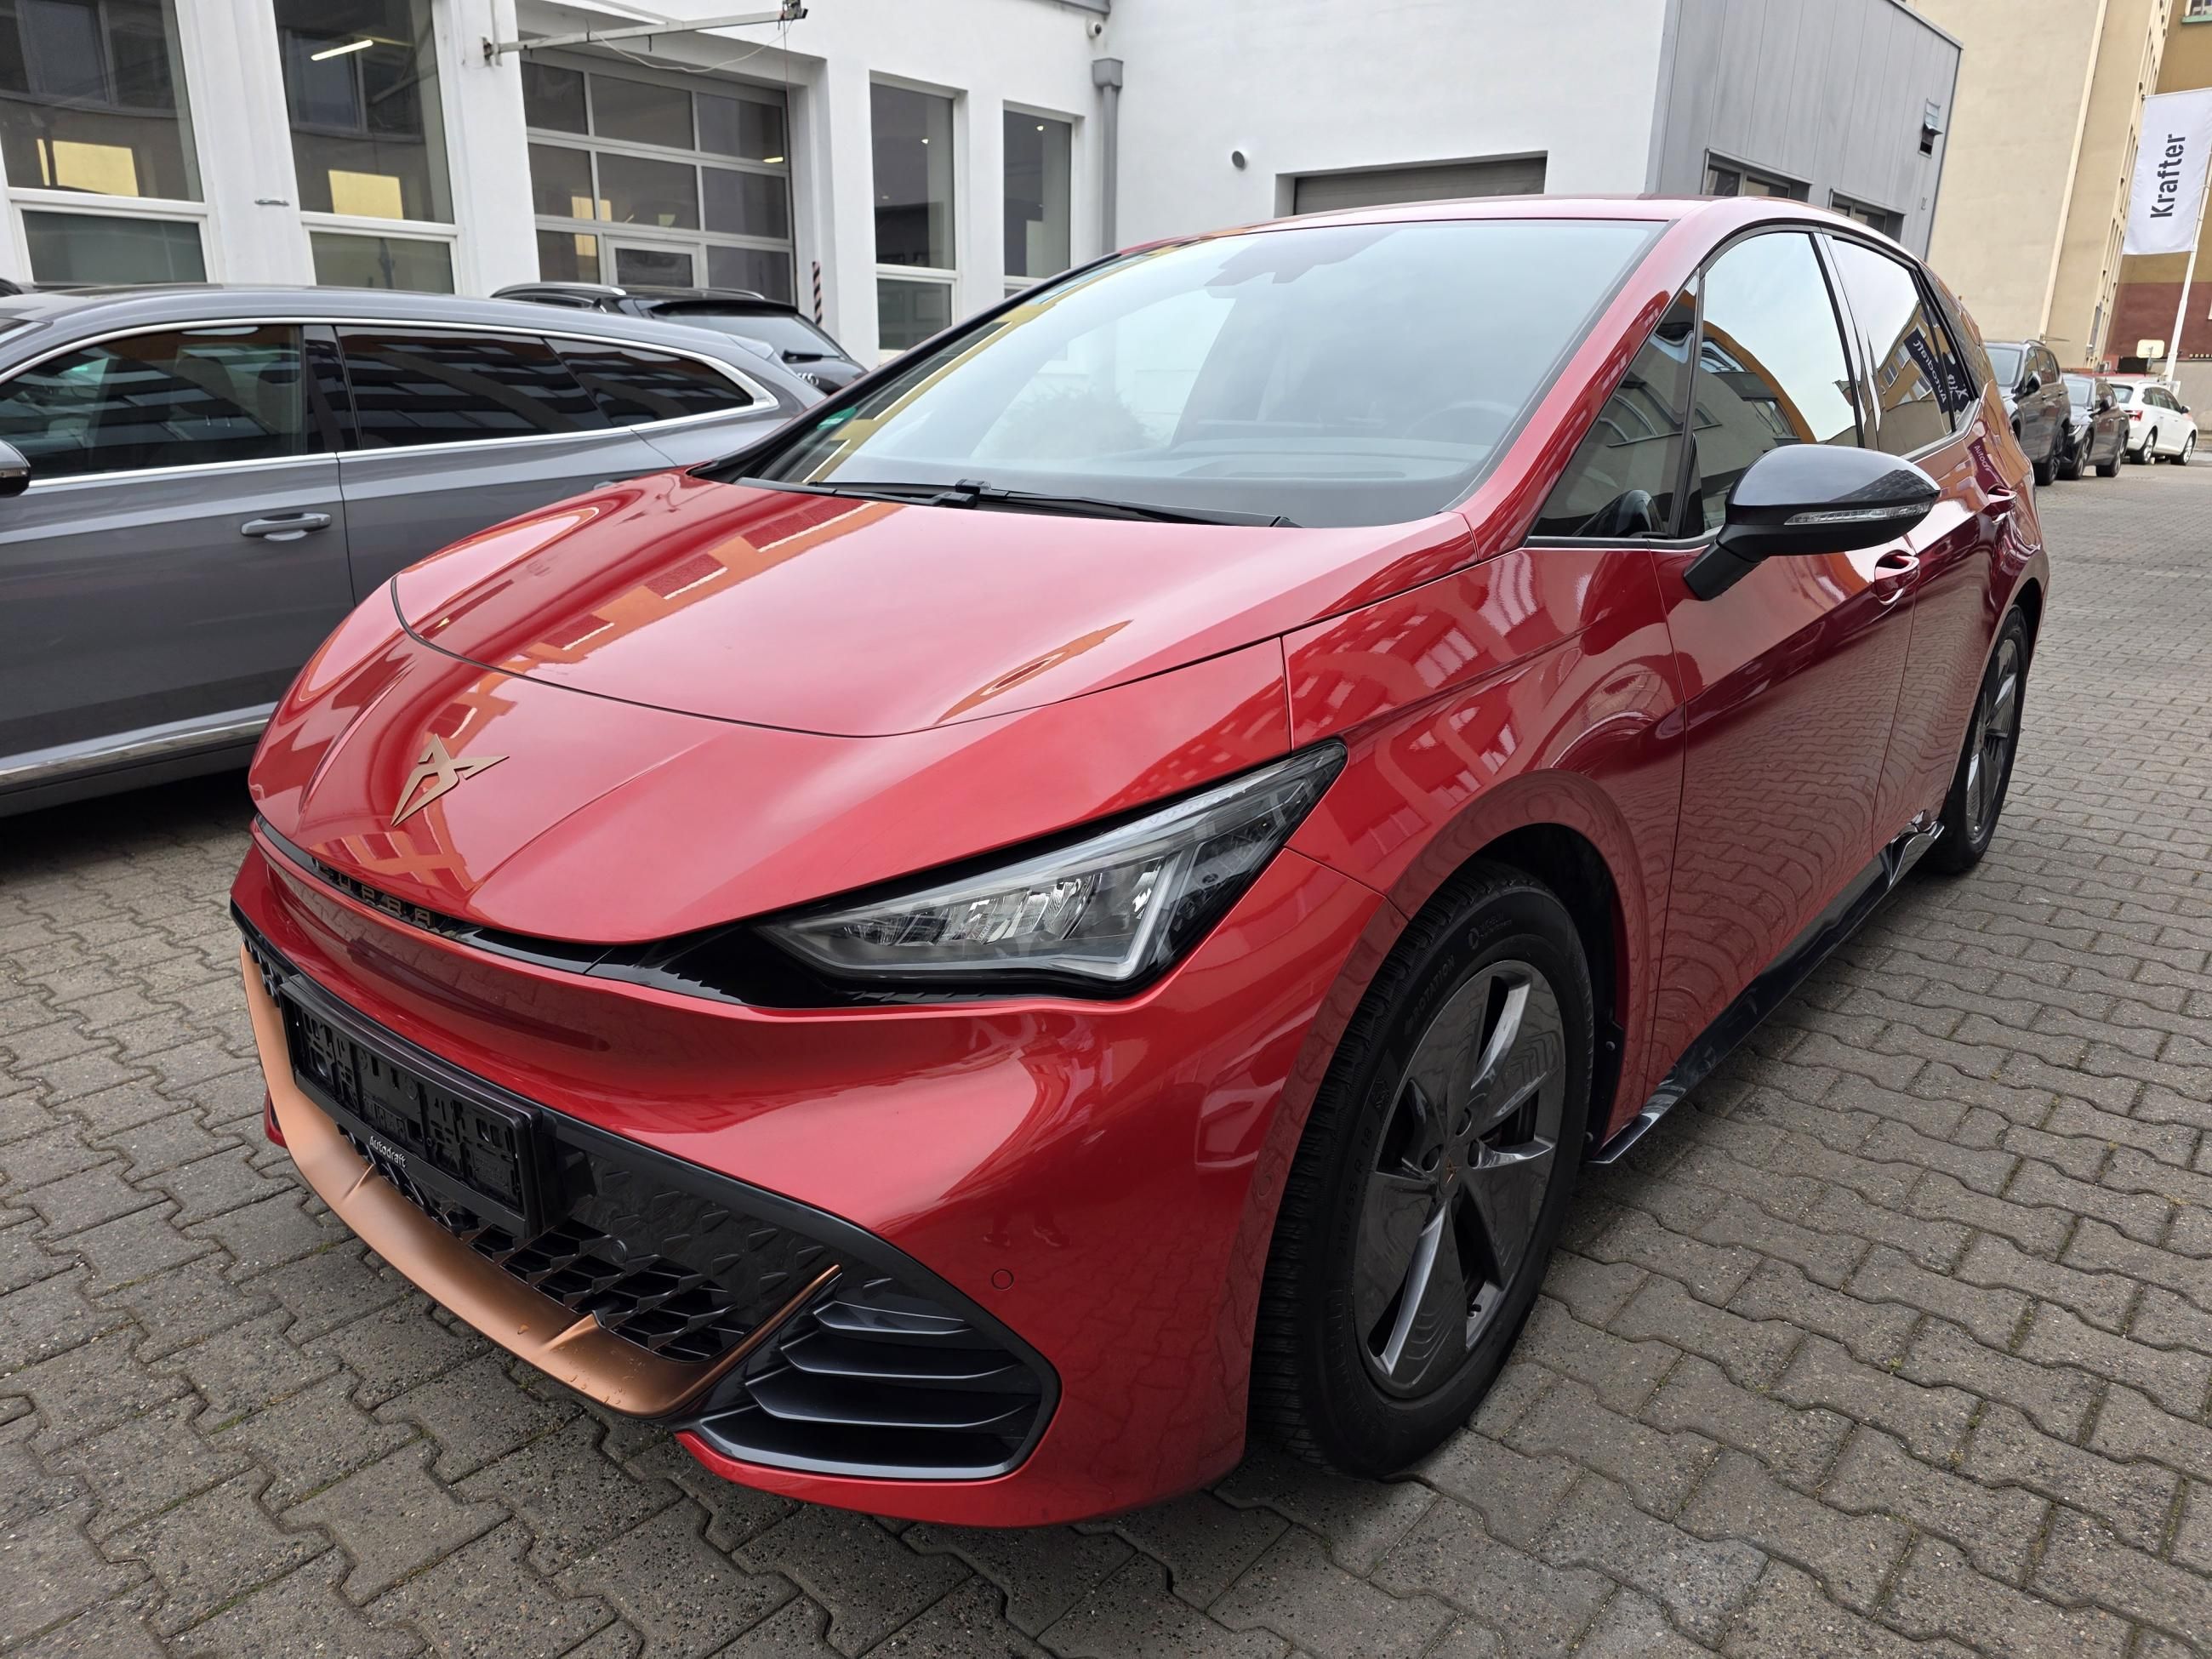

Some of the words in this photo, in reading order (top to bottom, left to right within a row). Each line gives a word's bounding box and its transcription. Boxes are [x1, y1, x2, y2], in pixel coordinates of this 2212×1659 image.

[2150, 134, 2186, 219] Krafter
[1411, 954, 1457, 1021] ROTATION
[368, 1136, 408, 1168] Autodraft
